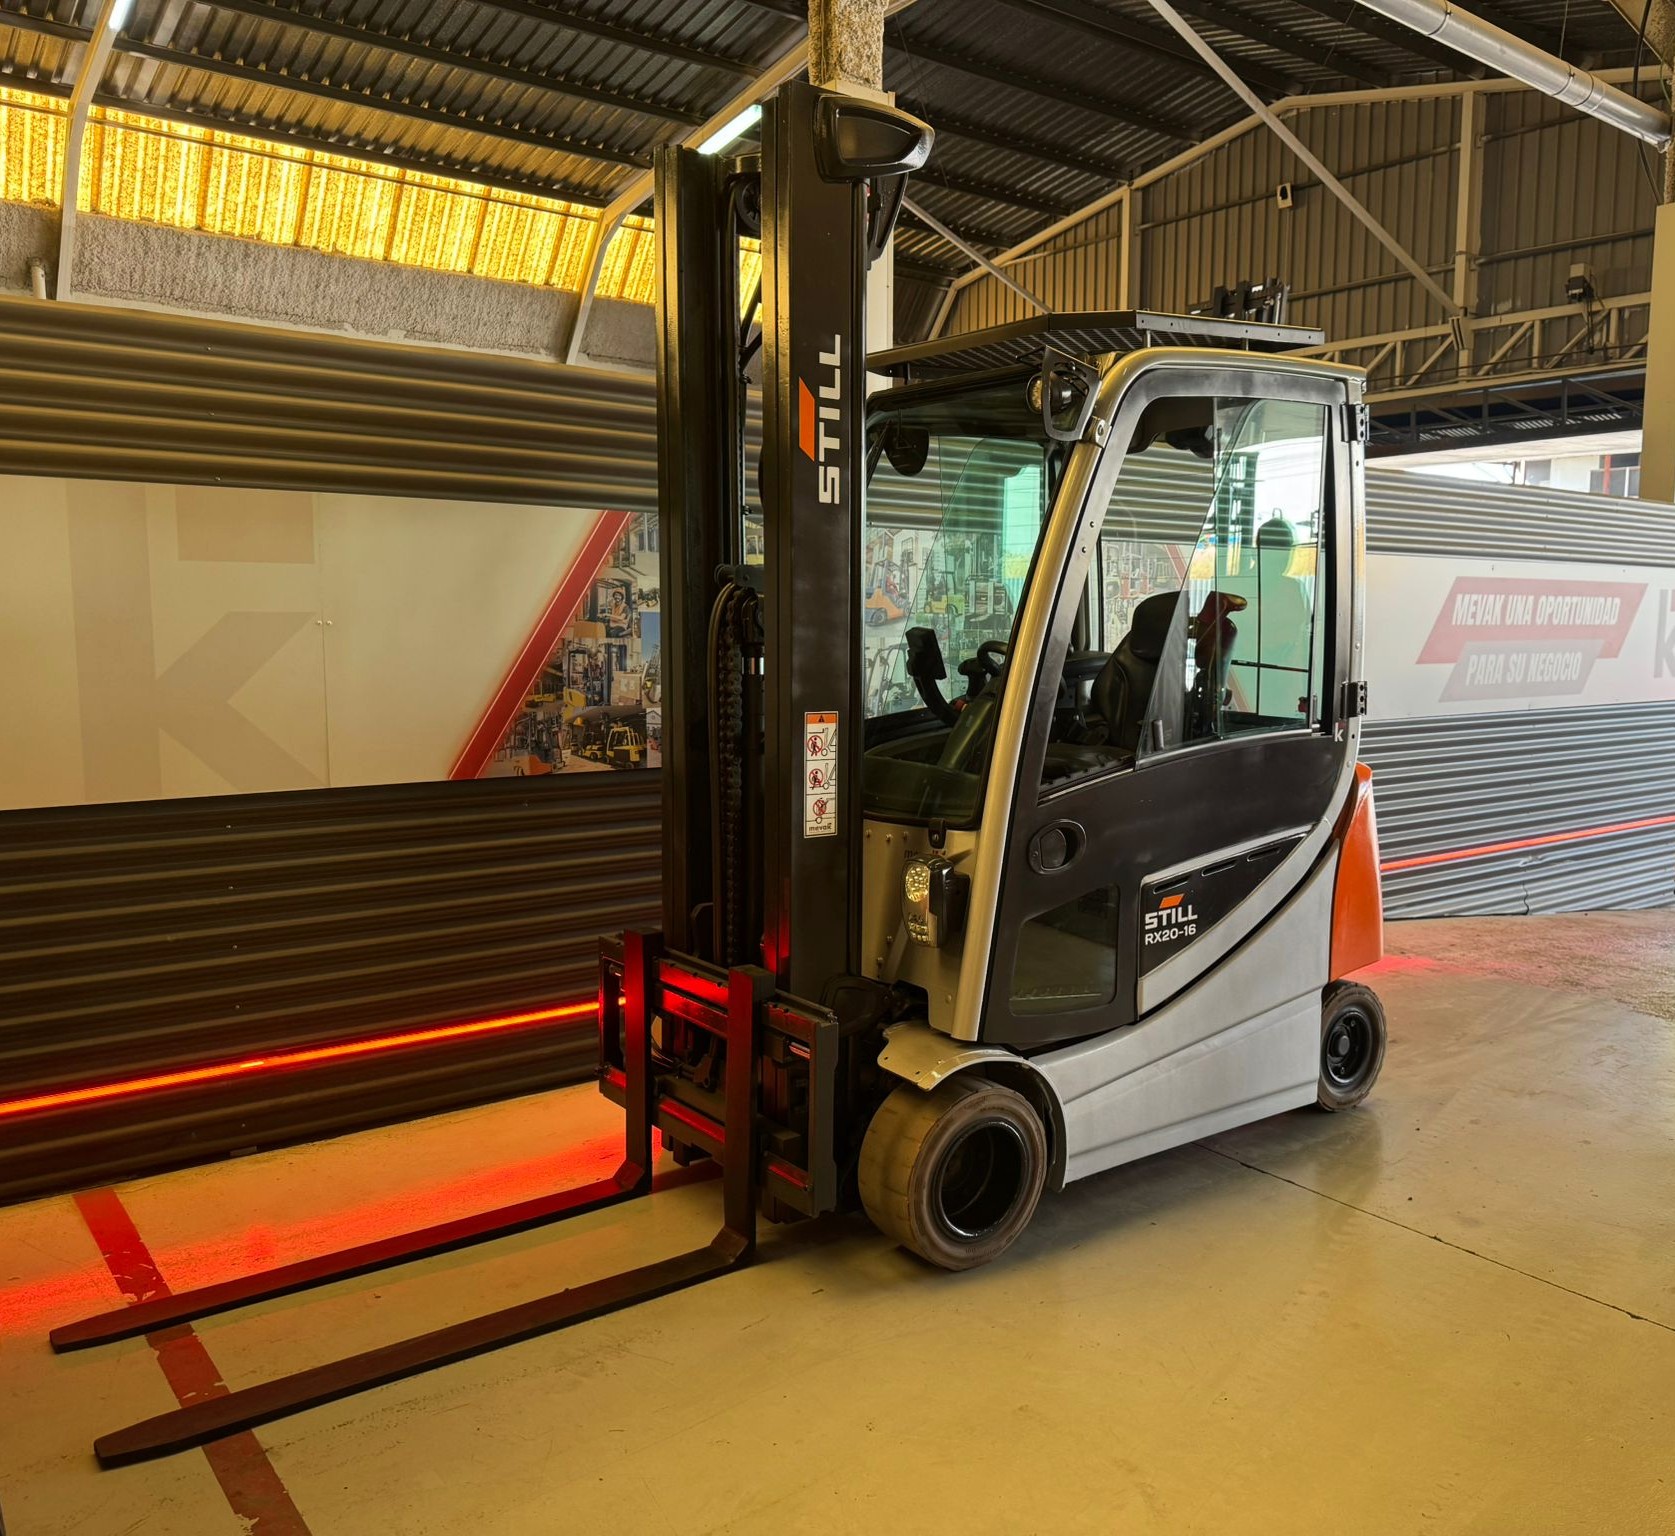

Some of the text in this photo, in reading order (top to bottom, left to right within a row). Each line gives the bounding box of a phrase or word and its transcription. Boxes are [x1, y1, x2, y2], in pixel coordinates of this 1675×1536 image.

[819, 334, 841, 504] STILL
[1452, 594, 1621, 626] MEVAK UNA OPORTUNIDAD
[1465, 652, 1583, 686] PARA SU NEGOCIO
[1144, 905, 1198, 930] STILL
[1144, 924, 1196, 946] RX20-16
